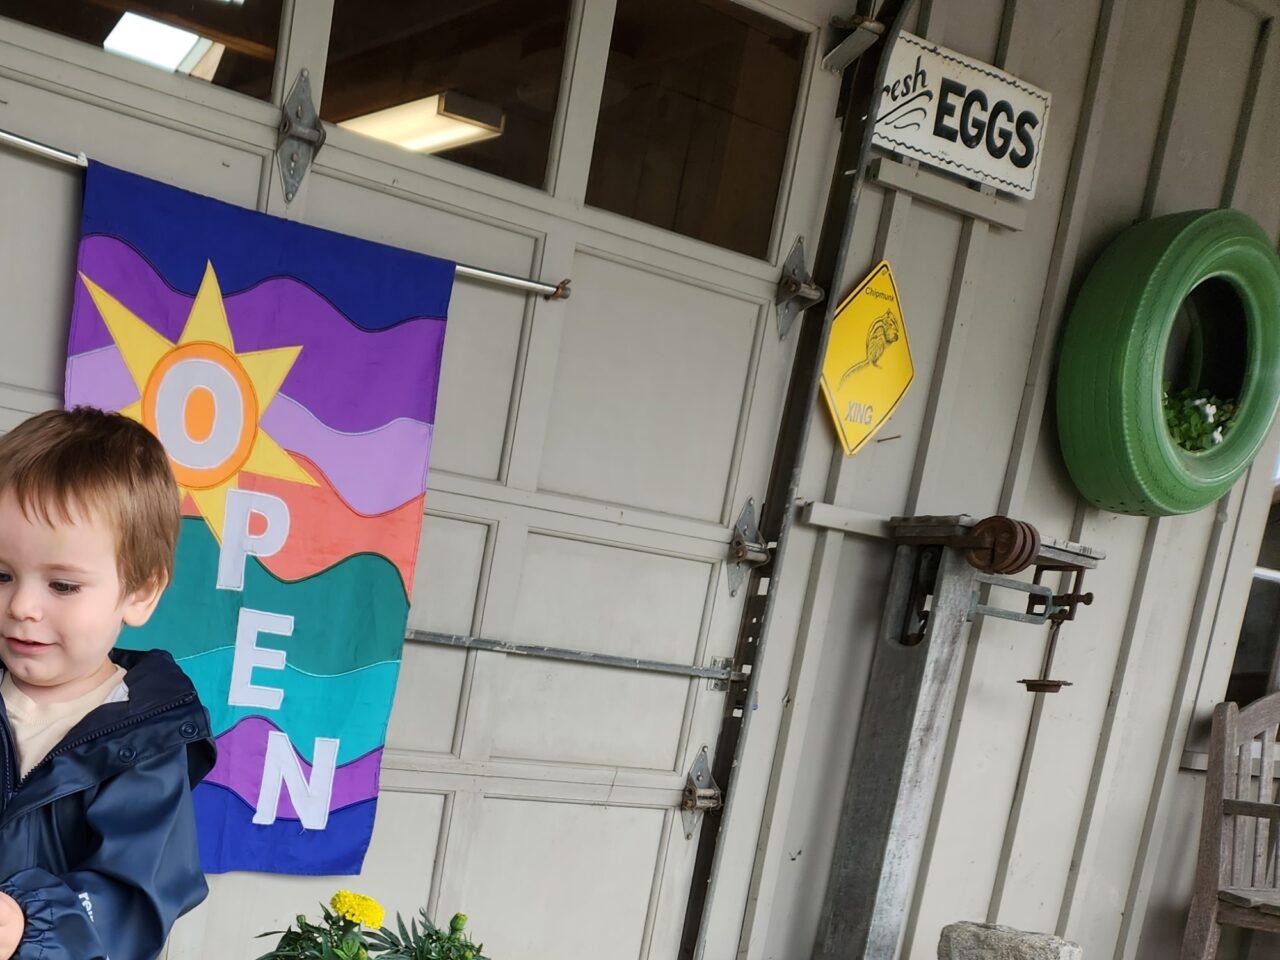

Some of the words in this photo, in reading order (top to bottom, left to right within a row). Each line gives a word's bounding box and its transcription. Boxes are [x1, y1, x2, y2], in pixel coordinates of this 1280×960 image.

[881, 55, 928, 102] resh
[933, 77, 1039, 168] EGGS
[865, 286, 895, 302] Chipmunk
[844, 400, 874, 426] XING
[153, 357, 340, 831] OPEN
